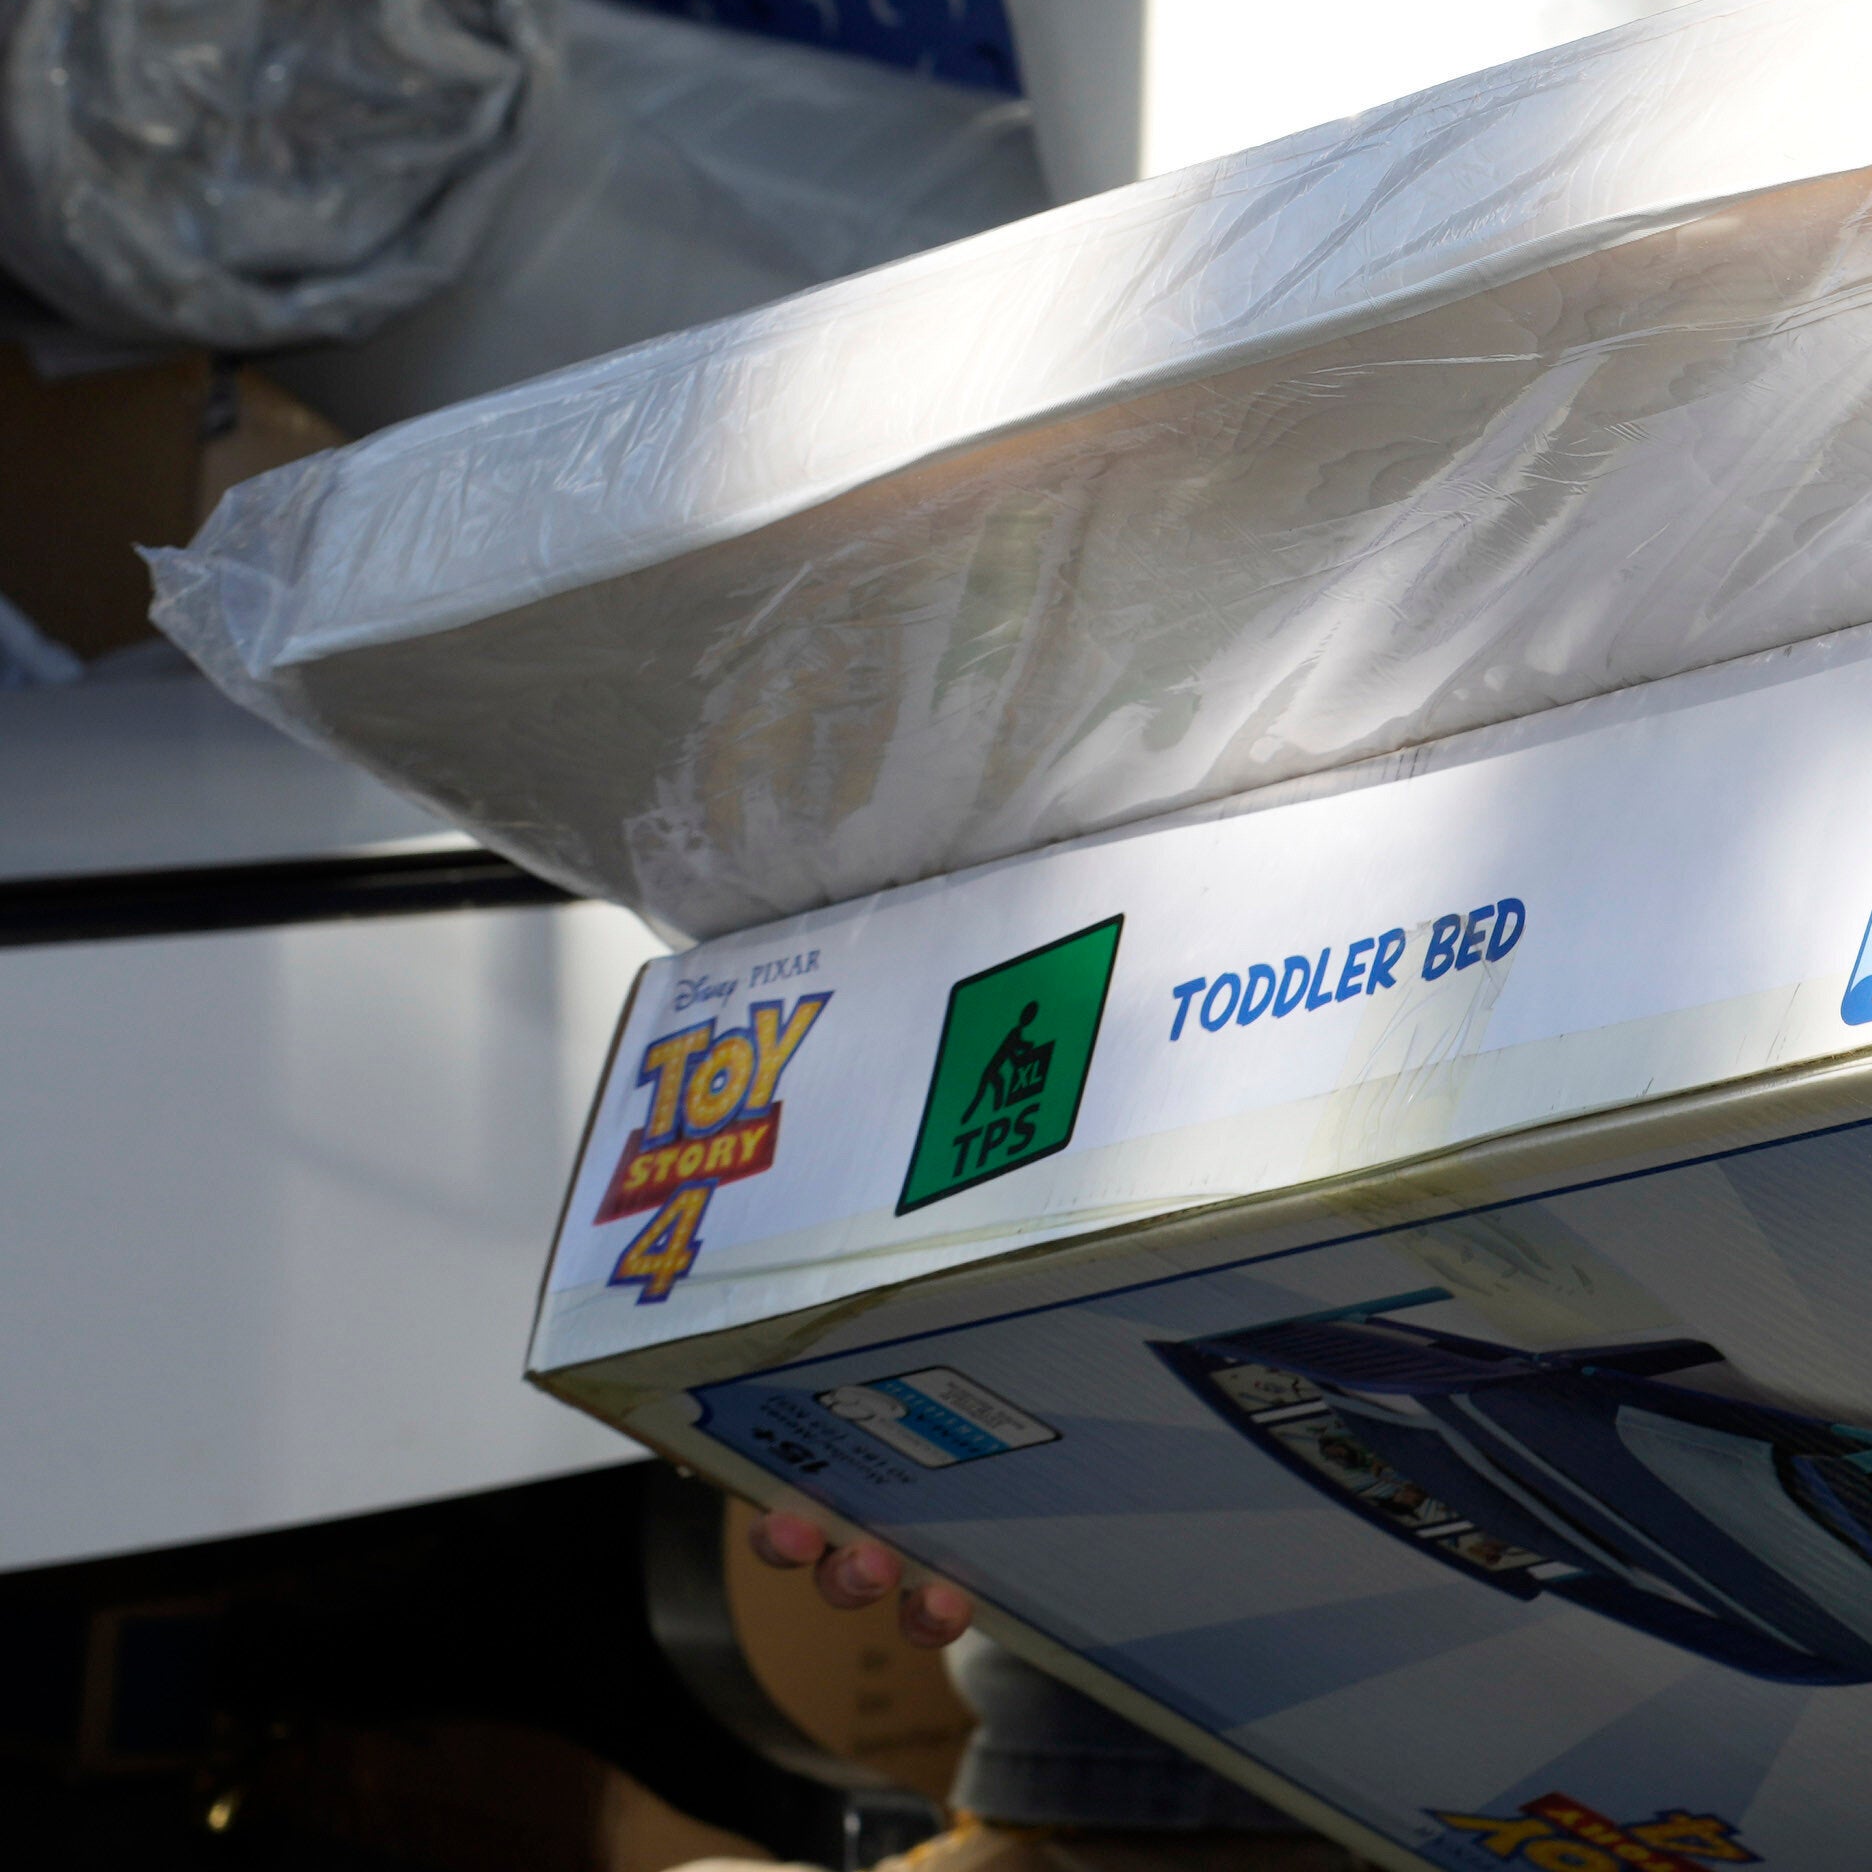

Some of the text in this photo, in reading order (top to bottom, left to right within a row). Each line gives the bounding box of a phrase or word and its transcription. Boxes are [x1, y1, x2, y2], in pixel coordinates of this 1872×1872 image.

[747, 949, 821, 990] PIXAR
[1169, 897, 1526, 1042] TODDLER BED
[635, 991, 835, 1152] TOY
[1011, 1062, 1044, 1095] XL
[624, 1124, 770, 1191] STORY
[950, 1102, 1042, 1179] TPS
[606, 1179, 718, 1306] 4
